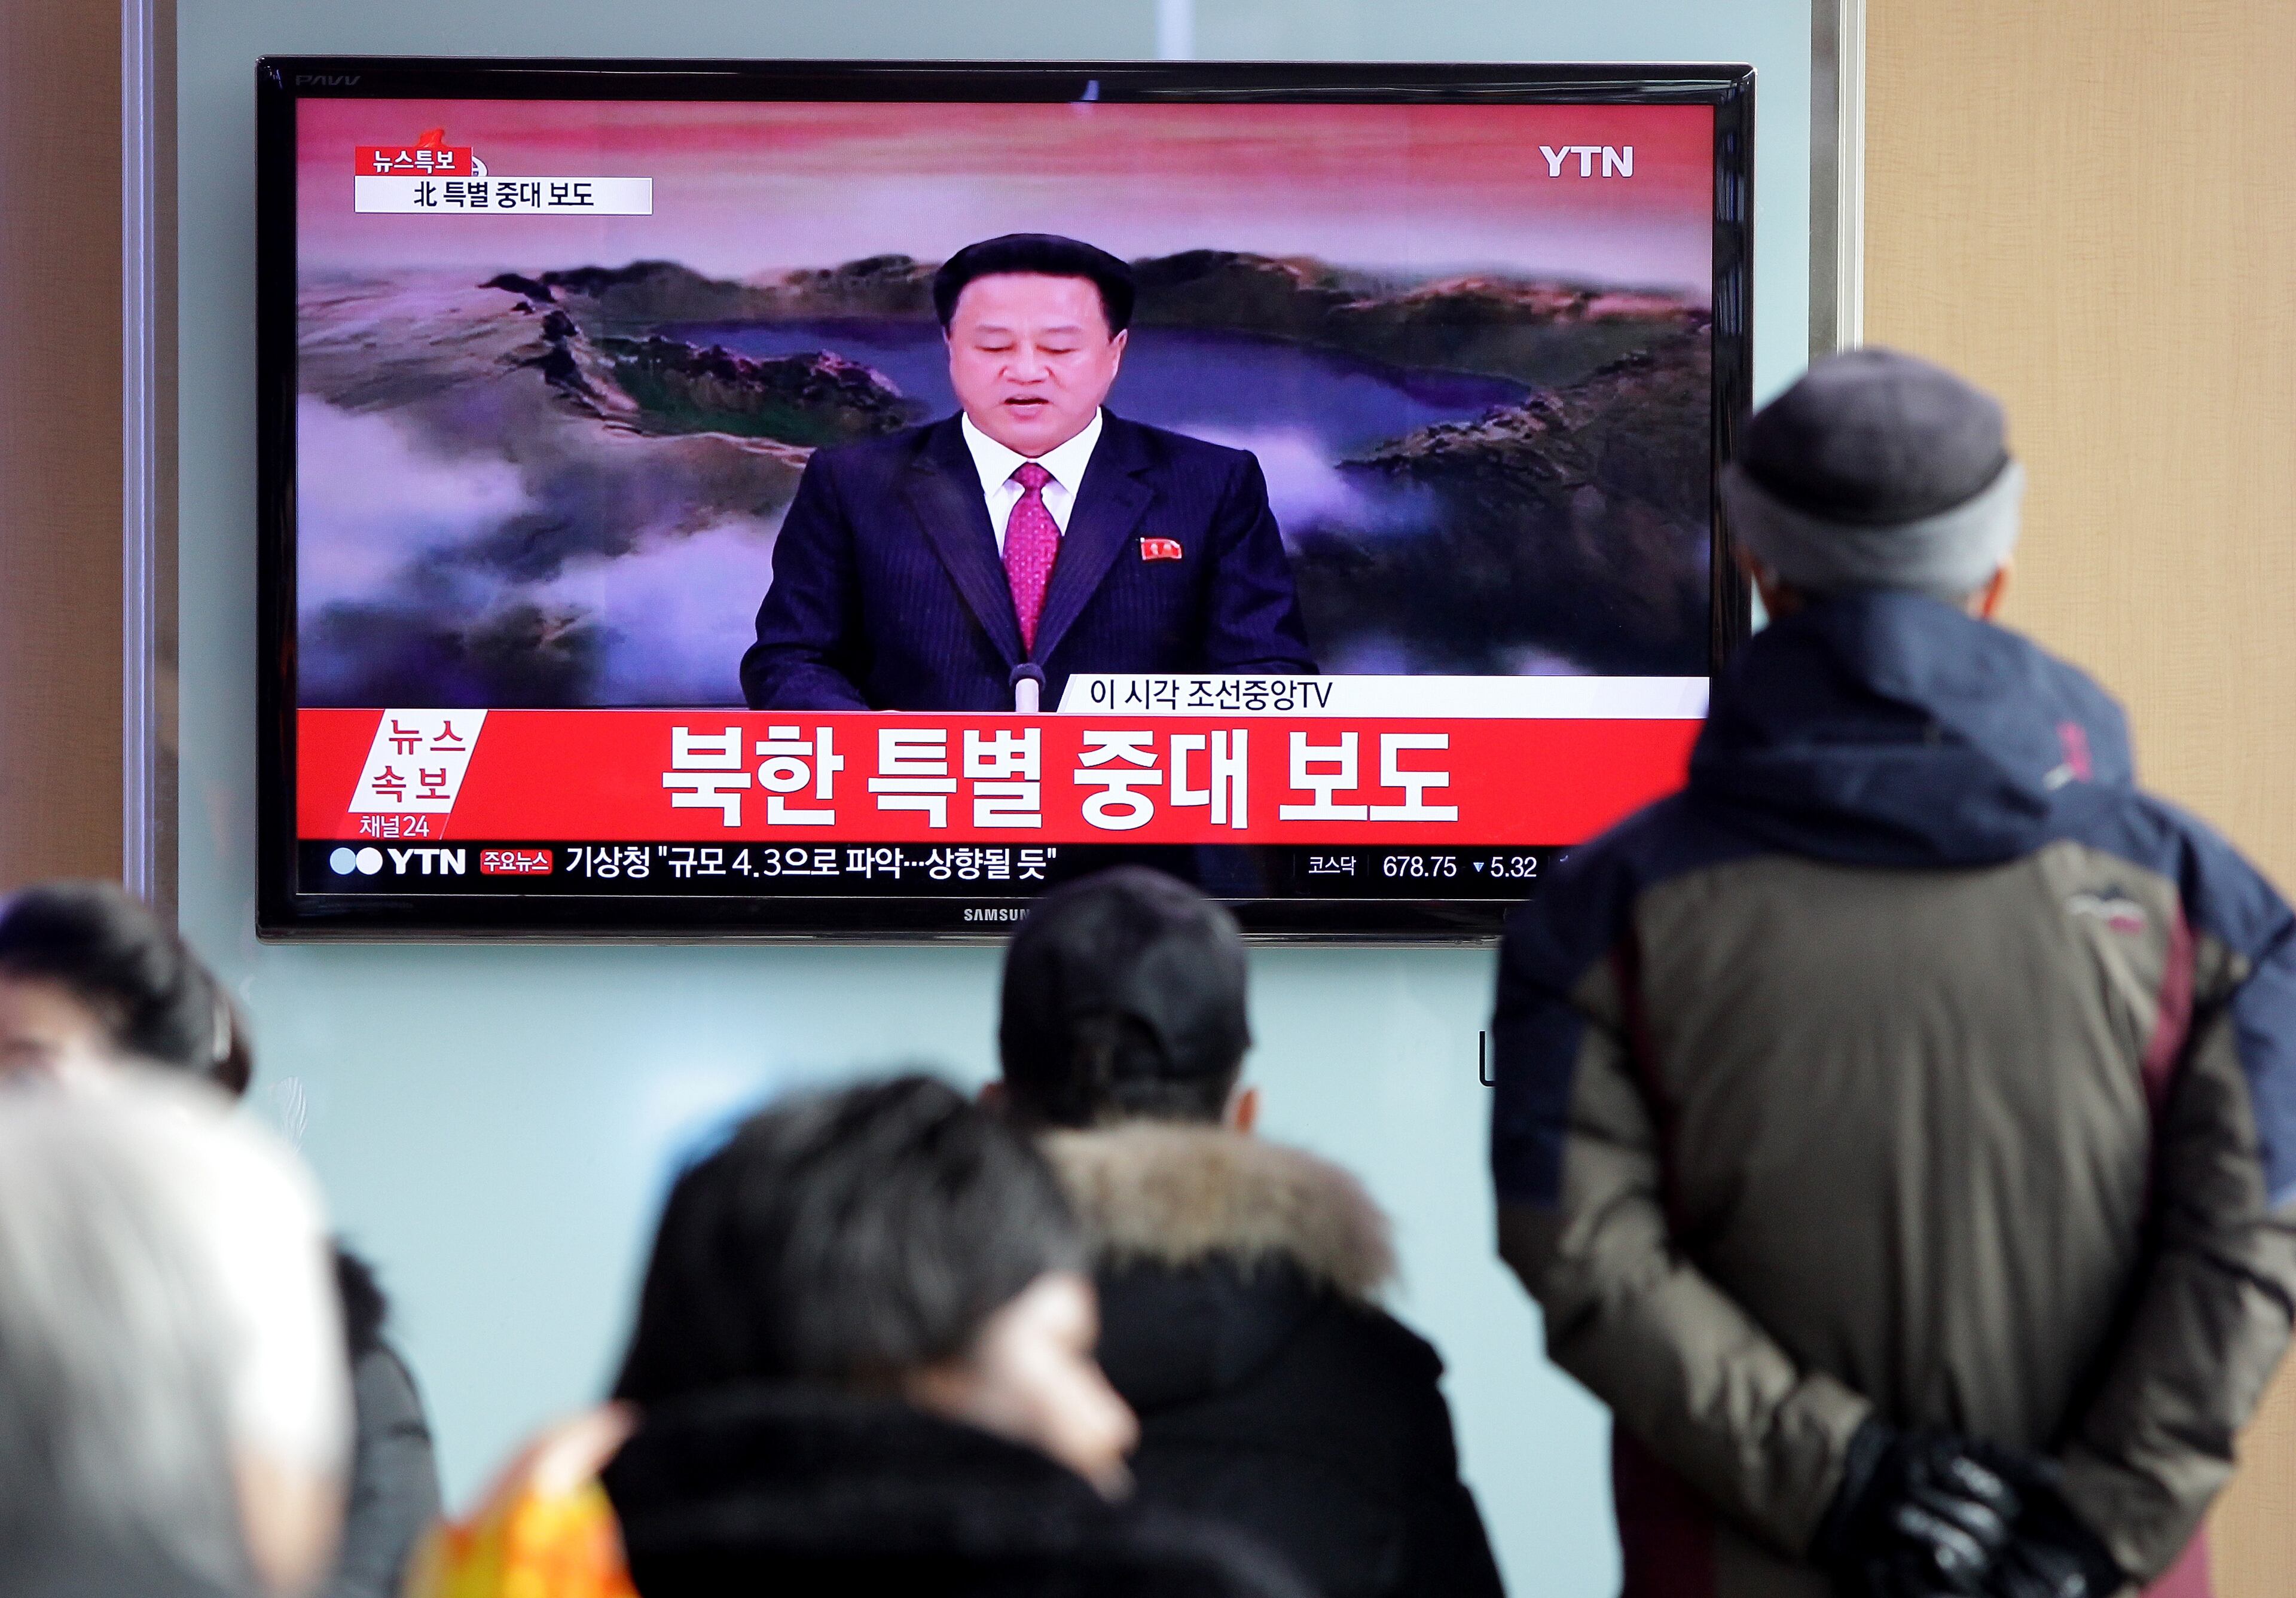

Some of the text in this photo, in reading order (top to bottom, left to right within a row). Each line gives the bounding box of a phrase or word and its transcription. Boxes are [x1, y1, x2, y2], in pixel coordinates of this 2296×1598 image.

[372, 149, 457, 173] 뉴스특보
[1538, 145, 1634, 178] YTN
[413, 181, 594, 208] 北 특별 중대 보도
[1089, 679, 1333, 710] 이 시각 조선중앙TV
[387, 719, 466, 756] 뉴스
[371, 765, 451, 803] 속보
[661, 725, 1460, 831] 북한 특별 중대 보도
[387, 848, 466, 875] YTN
[482, 853, 551, 873] 주요뉴스
[566, 847, 651, 878] 기상청
[732, 848, 841, 878] 4.3으로
[1308, 855, 1537, 878] 코스닥 678.75 5.32
[963, 908, 1030, 922] SAMSUN
